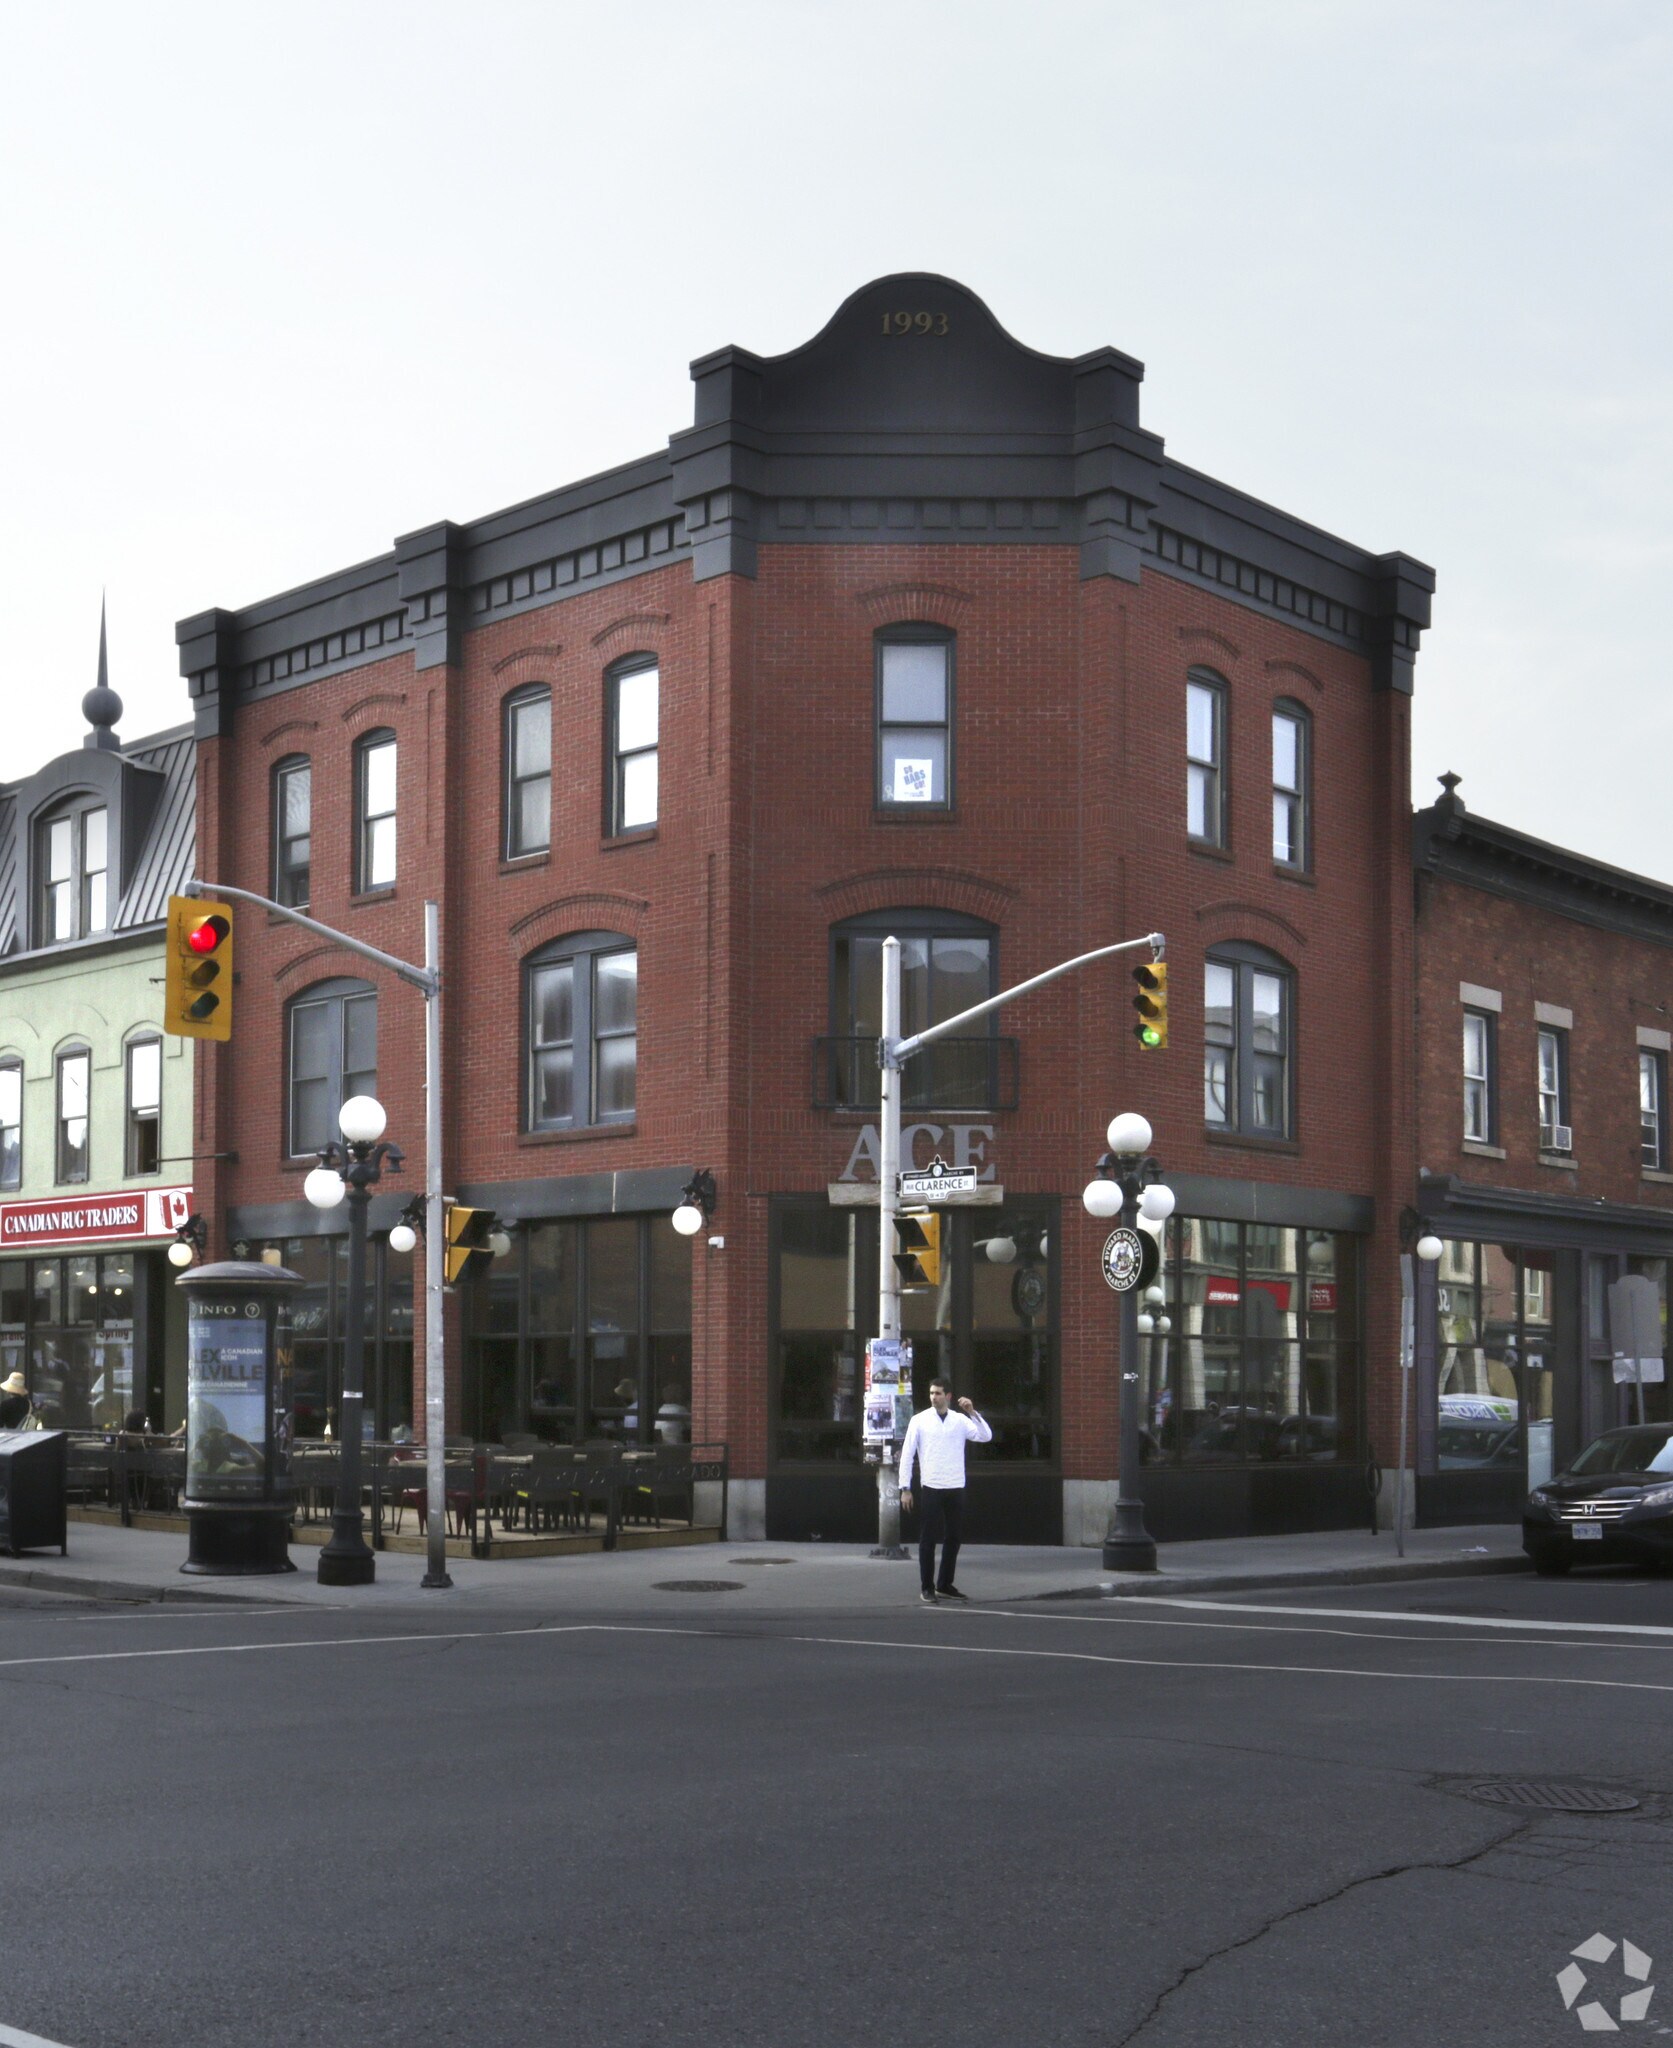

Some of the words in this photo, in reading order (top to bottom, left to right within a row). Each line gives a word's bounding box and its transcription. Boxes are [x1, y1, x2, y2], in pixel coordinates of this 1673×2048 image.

[881, 311, 949, 336] 1993
[838, 1123, 995, 1181] ACE
[915, 1179, 963, 1191] CLARENCE
[4, 1212, 60, 1235] CANADIAN
[61, 1210, 84, 1229] RUG
[85, 1205, 139, 1228] TRADERS
[1104, 1232, 1122, 1260] BYWARD
[1122, 1232, 1140, 1258] MARKET
[1128, 1270, 1136, 1282] BY
[199, 1305, 236, 1315] INFO
